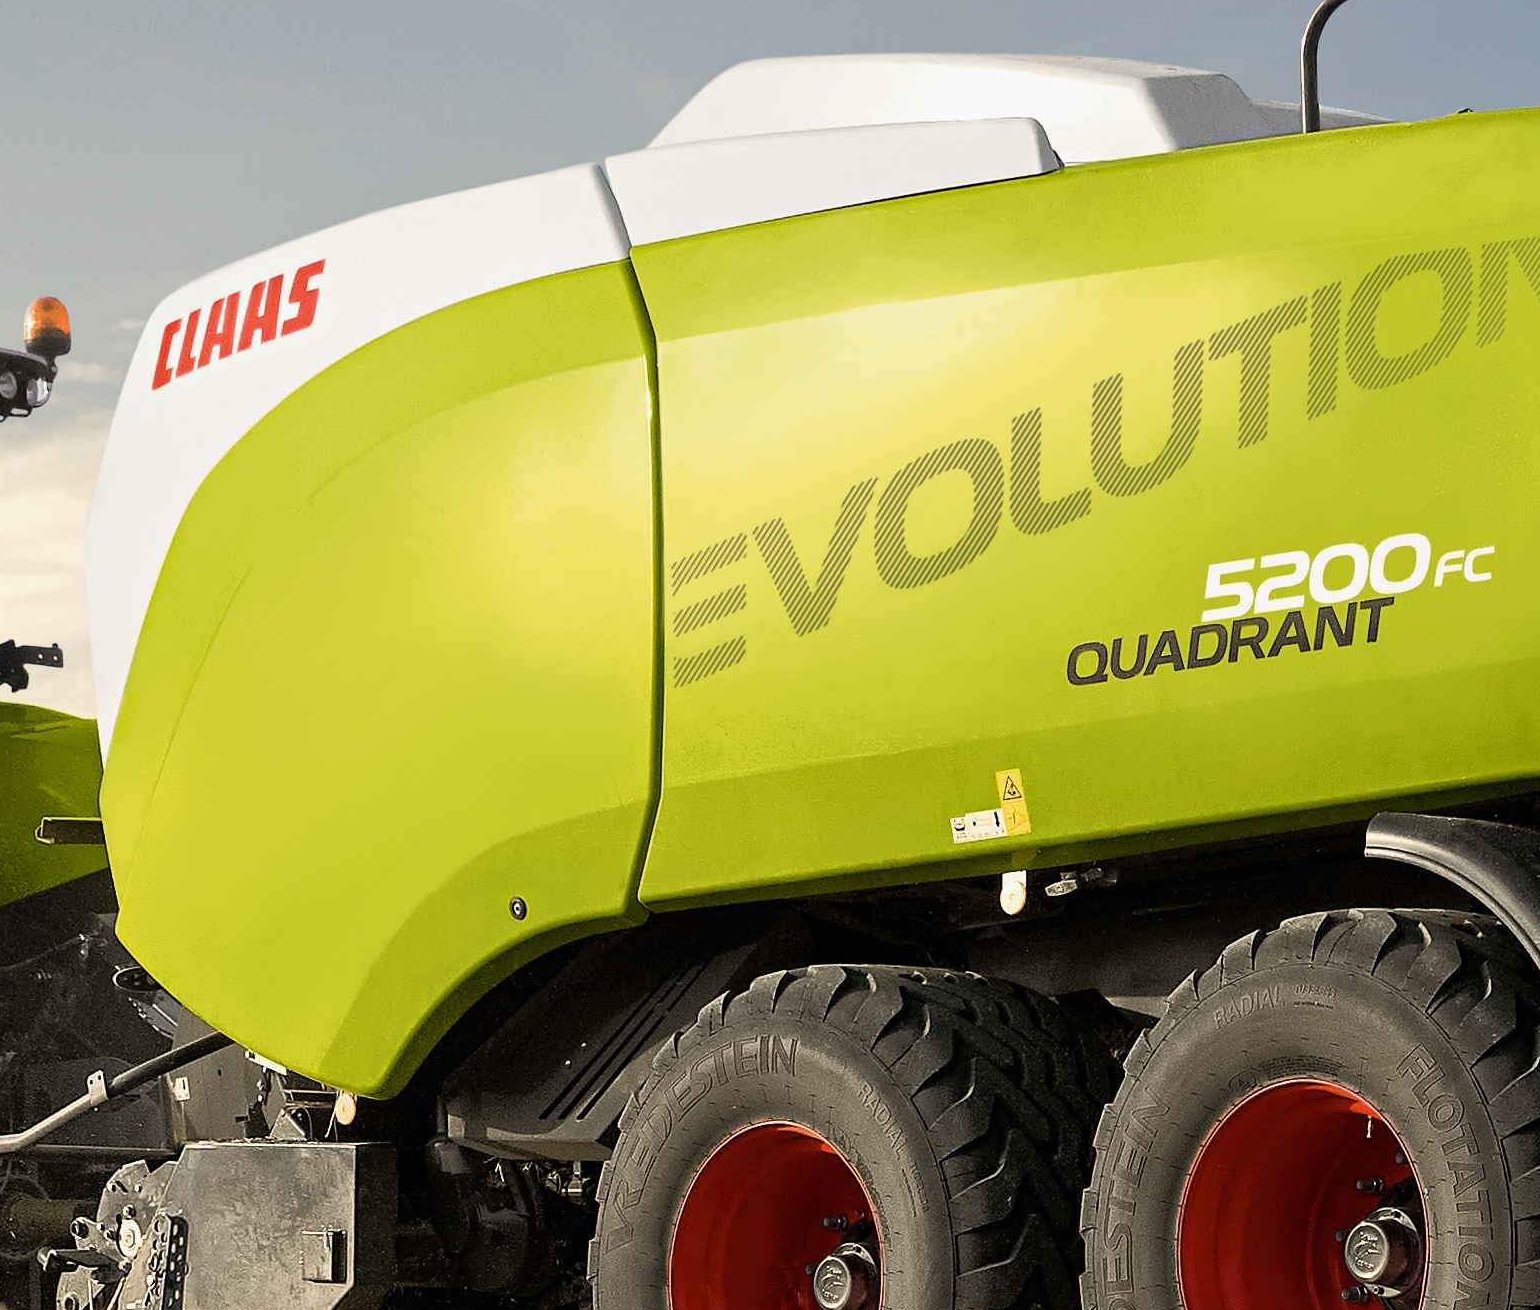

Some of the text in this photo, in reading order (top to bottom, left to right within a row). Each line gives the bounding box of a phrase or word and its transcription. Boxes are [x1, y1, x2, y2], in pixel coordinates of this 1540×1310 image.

[151, 259, 327, 392] CLAAS
[1201, 532, 1495, 623] 5200 FC
[1065, 597, 1396, 686] QUADRANT
[1213, 985, 1281, 1031] RADIAL
[605, 1033, 800, 1254] VREDESTEIN
[856, 1078, 908, 1161] RADIAL
